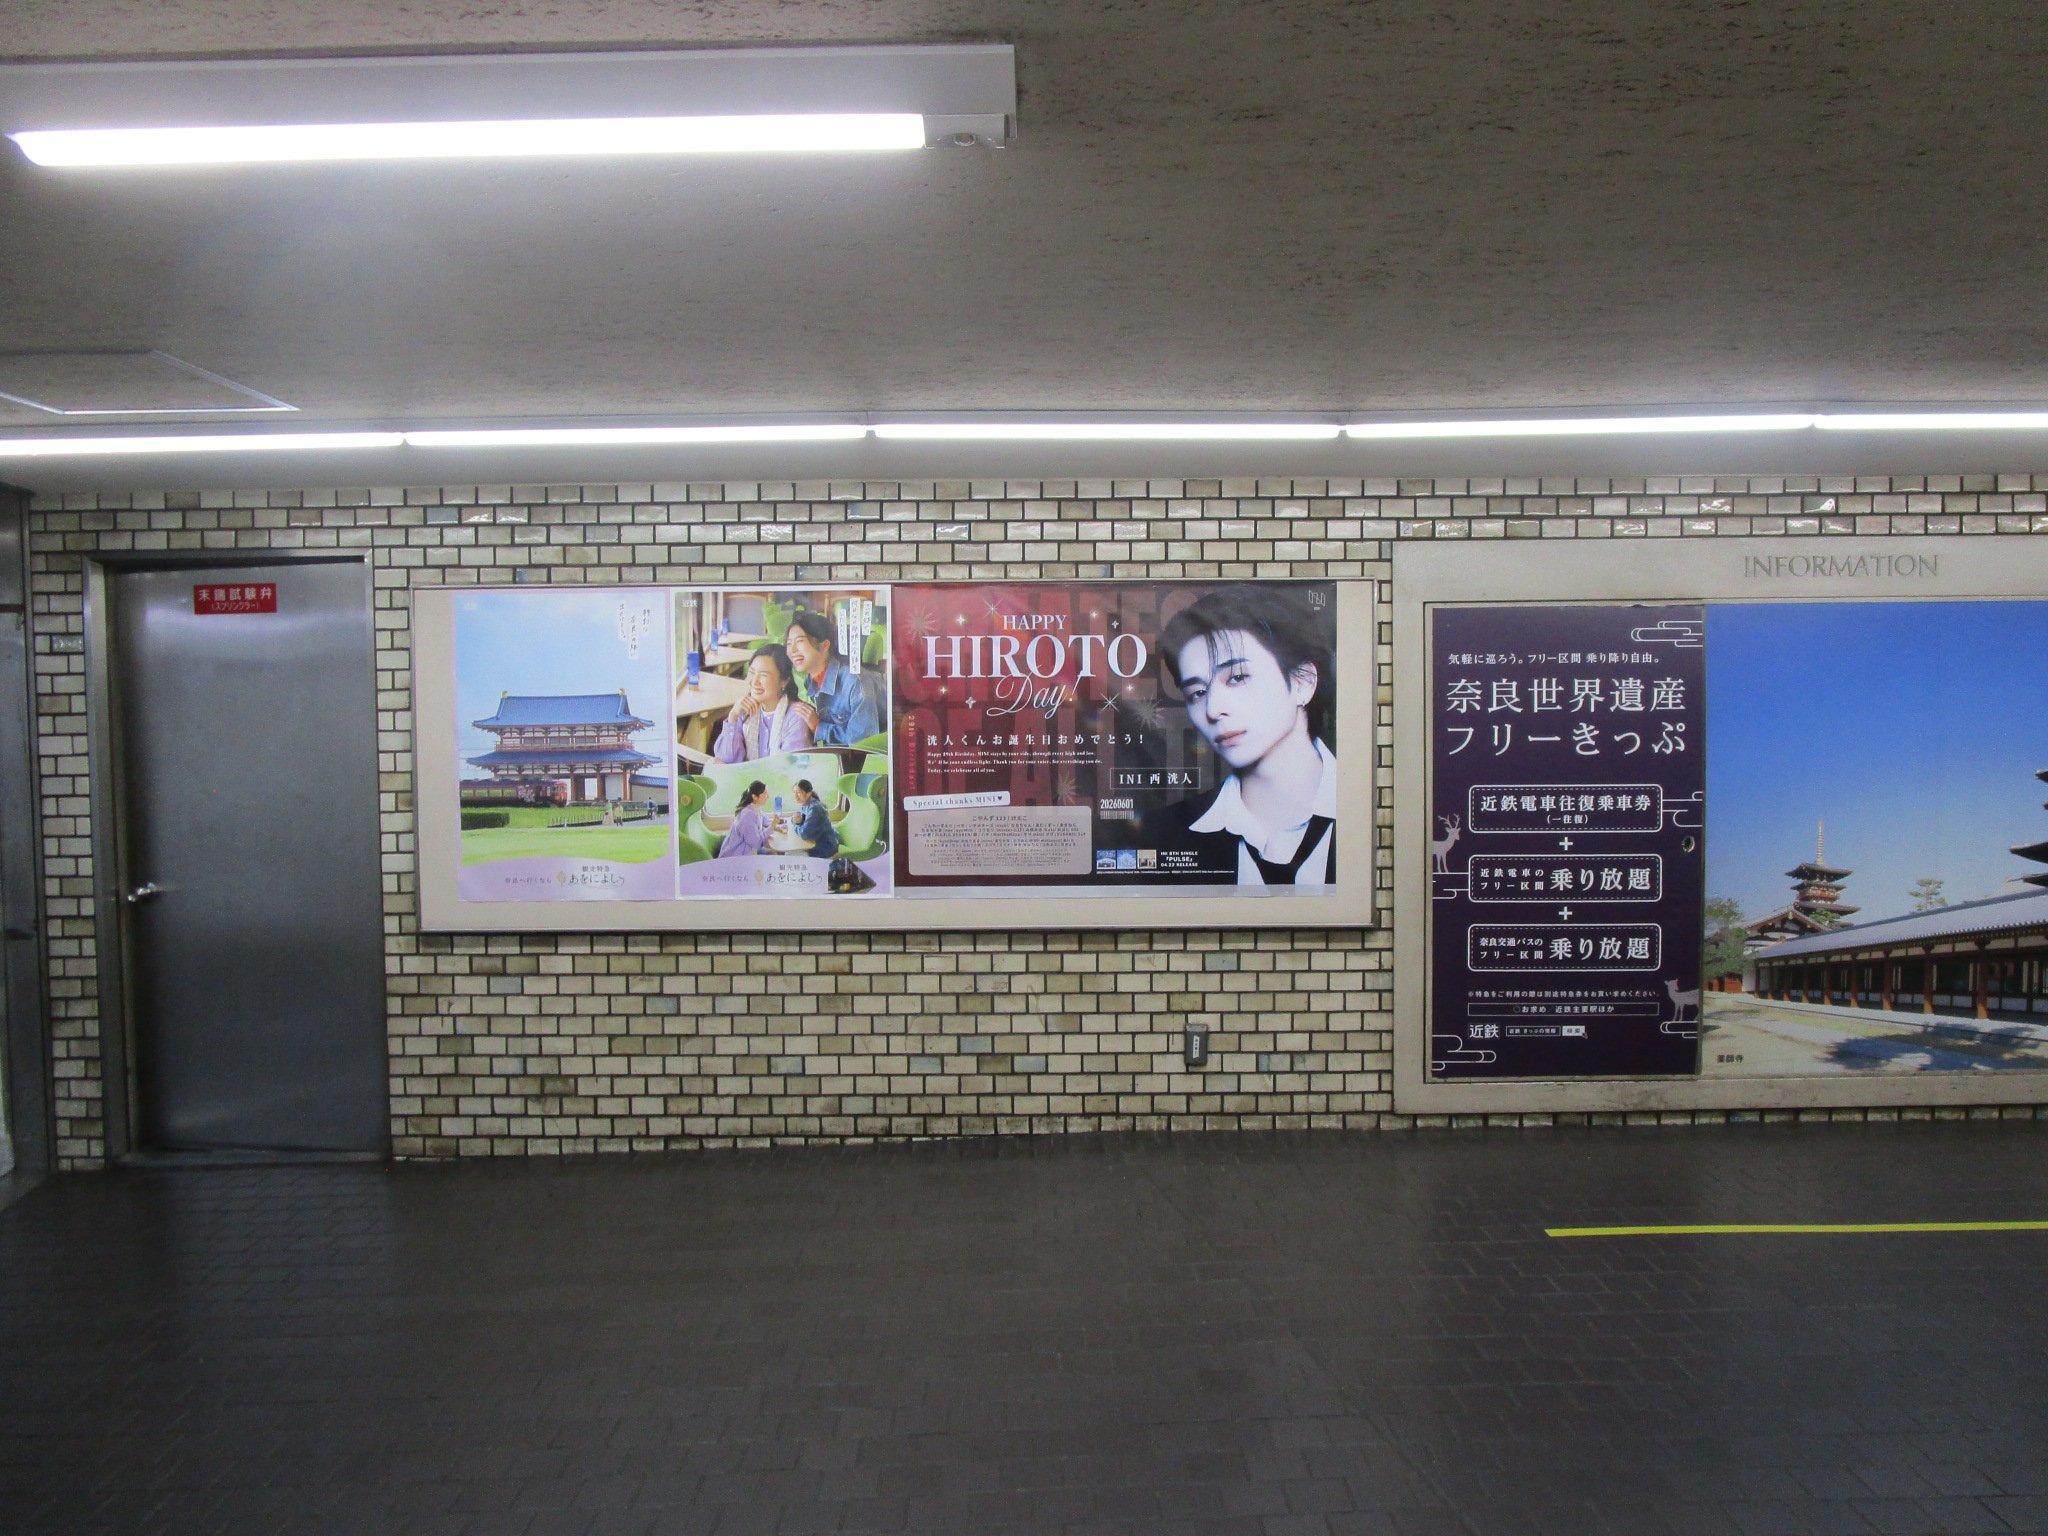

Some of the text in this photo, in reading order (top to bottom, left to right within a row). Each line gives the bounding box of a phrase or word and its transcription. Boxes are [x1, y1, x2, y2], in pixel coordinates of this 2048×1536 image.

[1744, 555, 1938, 578] INFORMATION
[1003, 614, 1067, 630] HAPPY
[922, 633, 1147, 679] HIROTO
[987, 664, 1085, 720] Day!
[1446, 677, 1686, 713] 奈良世界遺産
[1447, 721, 1686, 756] フリーきっぷ
[1119, 772, 1192, 785] INI 西 洸人
[912, 795, 996, 808] Special thanks MINI
[1100, 798, 1134, 809] 20260601
[1480, 794, 1651, 812] 近鉄電車往復乗車券
[1480, 868, 1544, 878] 近鉄電車の
[1550, 867, 1651, 892] 乗り放題
[1480, 881, 1544, 891] フリー区間
[1479, 937, 1543, 947] 奈良交通バスの
[1549, 937, 1650, 961] 乗り放題
[1480, 950, 1543, 960] フリー区間
[1469, 1024, 1499, 1039] 近鉄
